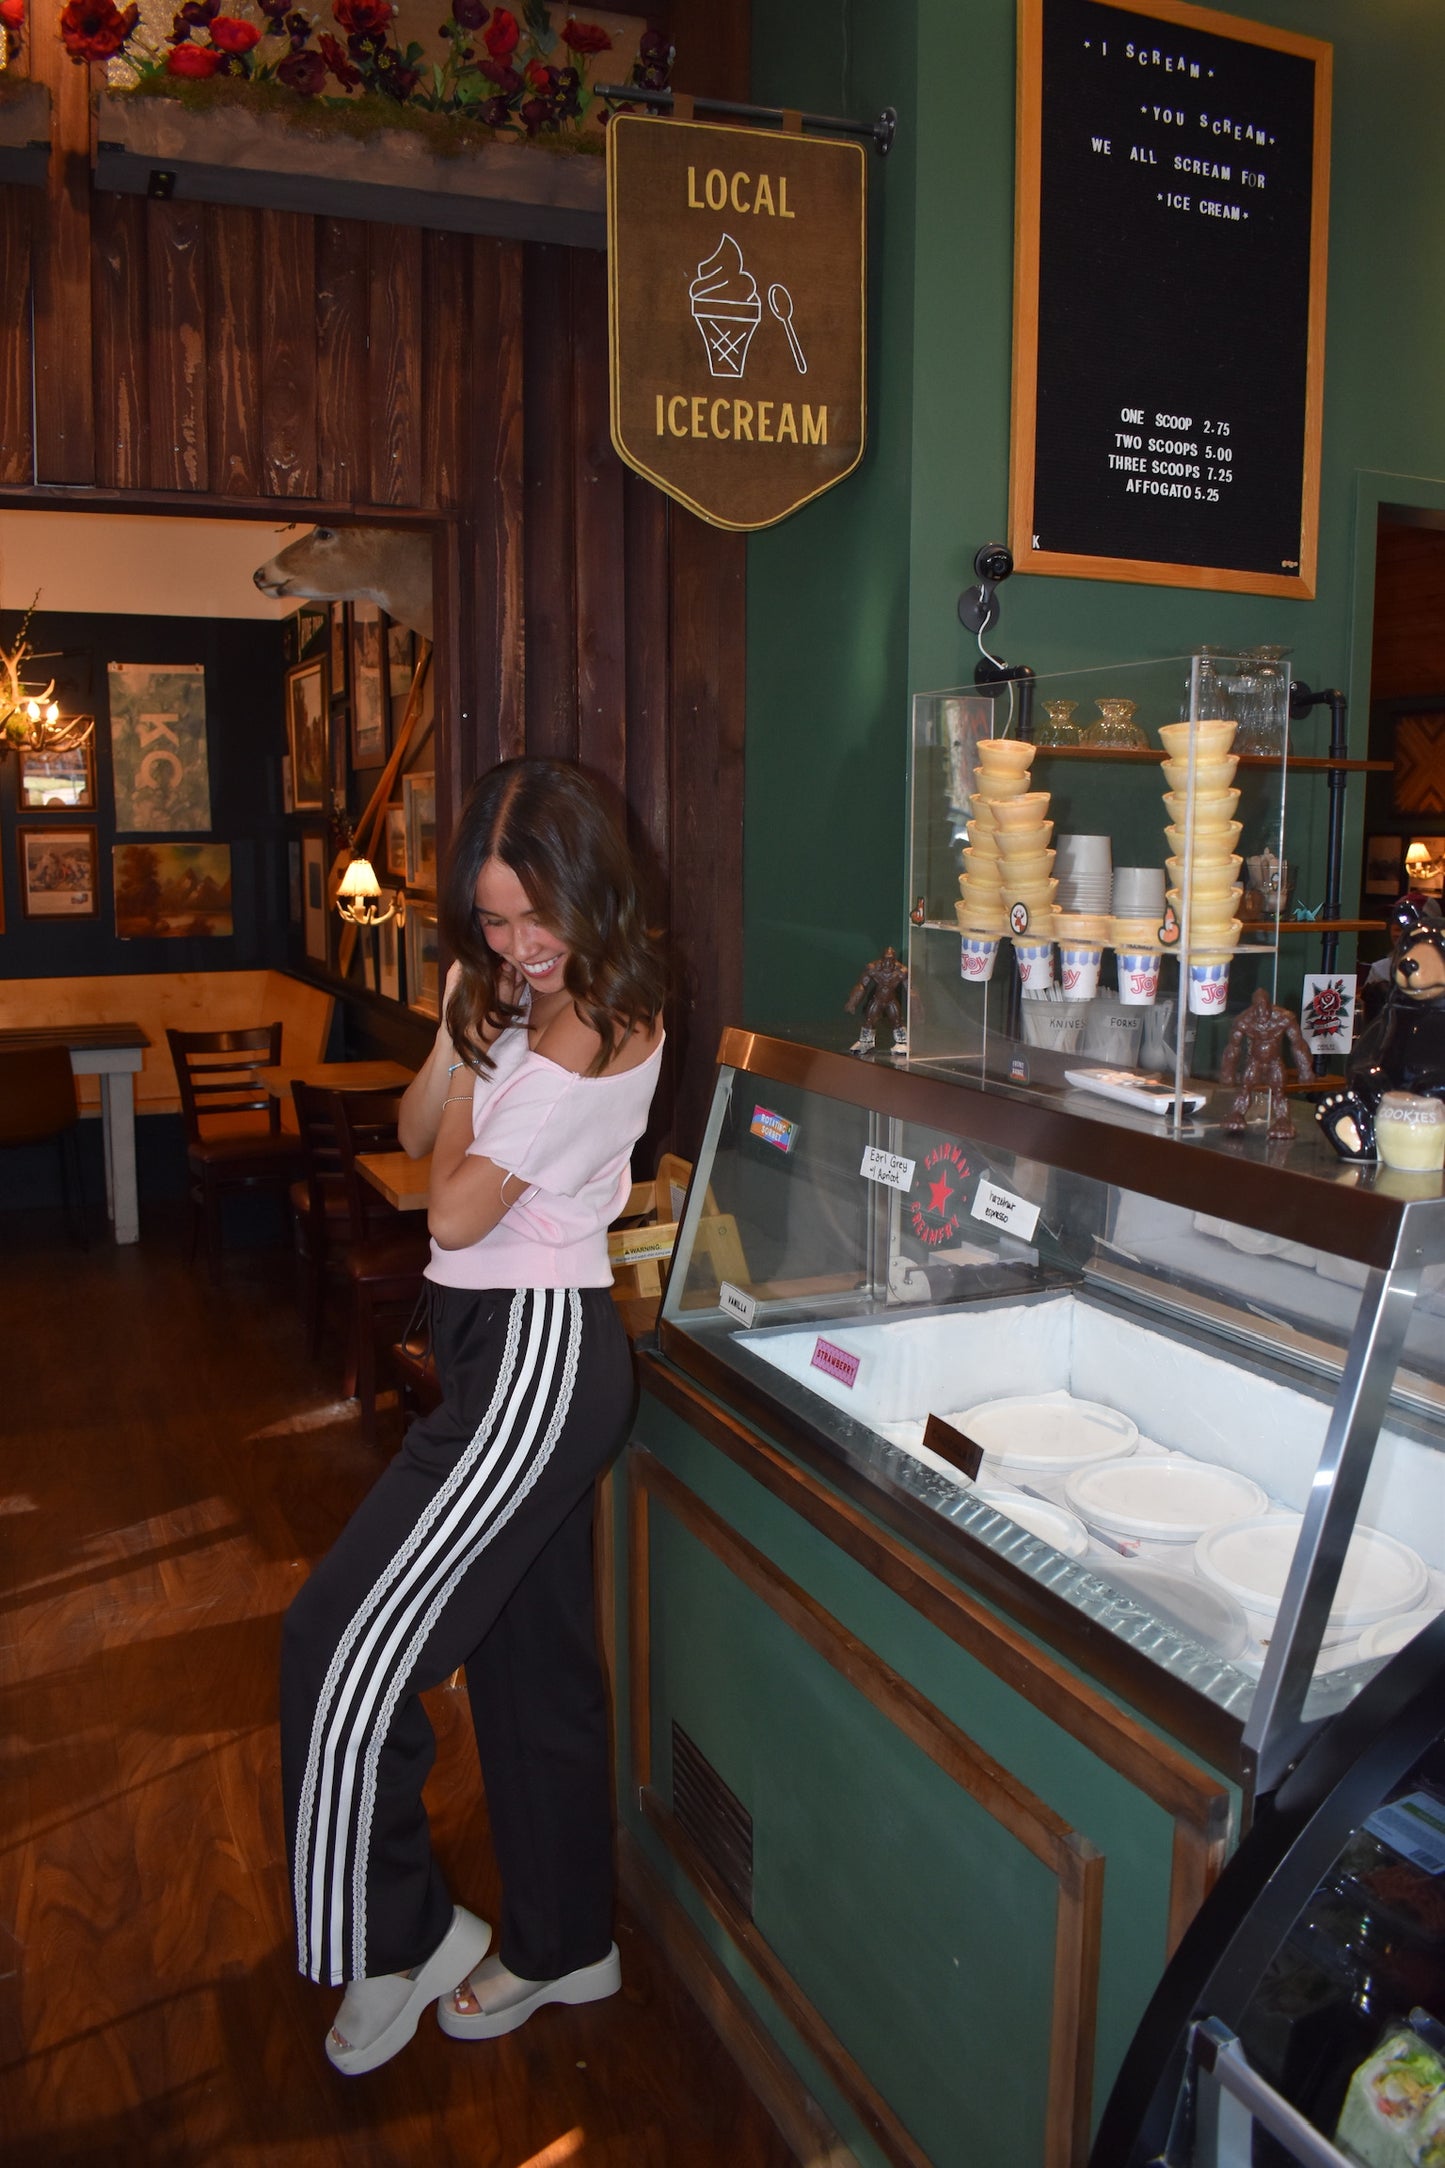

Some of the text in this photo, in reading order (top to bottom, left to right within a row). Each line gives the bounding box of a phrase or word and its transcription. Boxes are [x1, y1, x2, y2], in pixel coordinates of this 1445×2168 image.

[1126, 44, 1199, 78] SCREAM
[1154, 107, 1265, 145] YOU SCREAM
[1092, 138, 1265, 188] WE ALL SCREAM FOR
[688, 167, 795, 218] LOCAL
[1168, 193, 1240, 220] ICE CREAM
[656, 395, 827, 445] ICECREAM
[1121, 408, 1229, 436] ONE SCOOP 2.75
[1115, 434, 1232, 461] TWO SCOOPS 5.00
[1108, 454, 1232, 482] THREE SCOOPS 7.25
[1126, 479, 1219, 501] AFFOGATO 5.25
[1033, 535, 1039, 548] K
[961, 953, 989, 975] Joy
[1050, 1019, 1086, 1030] KNIVES
[1110, 1017, 1138, 1028] FORKS
[1380, 1108, 1437, 1123] COOKIES
[870, 1149, 908, 1173] Earl Grey
[924, 1142, 970, 1179] FAIRWAY
[911, 1201, 960, 1246] CREAMERY
[816, 1349, 855, 1376] STRAWBERRY
